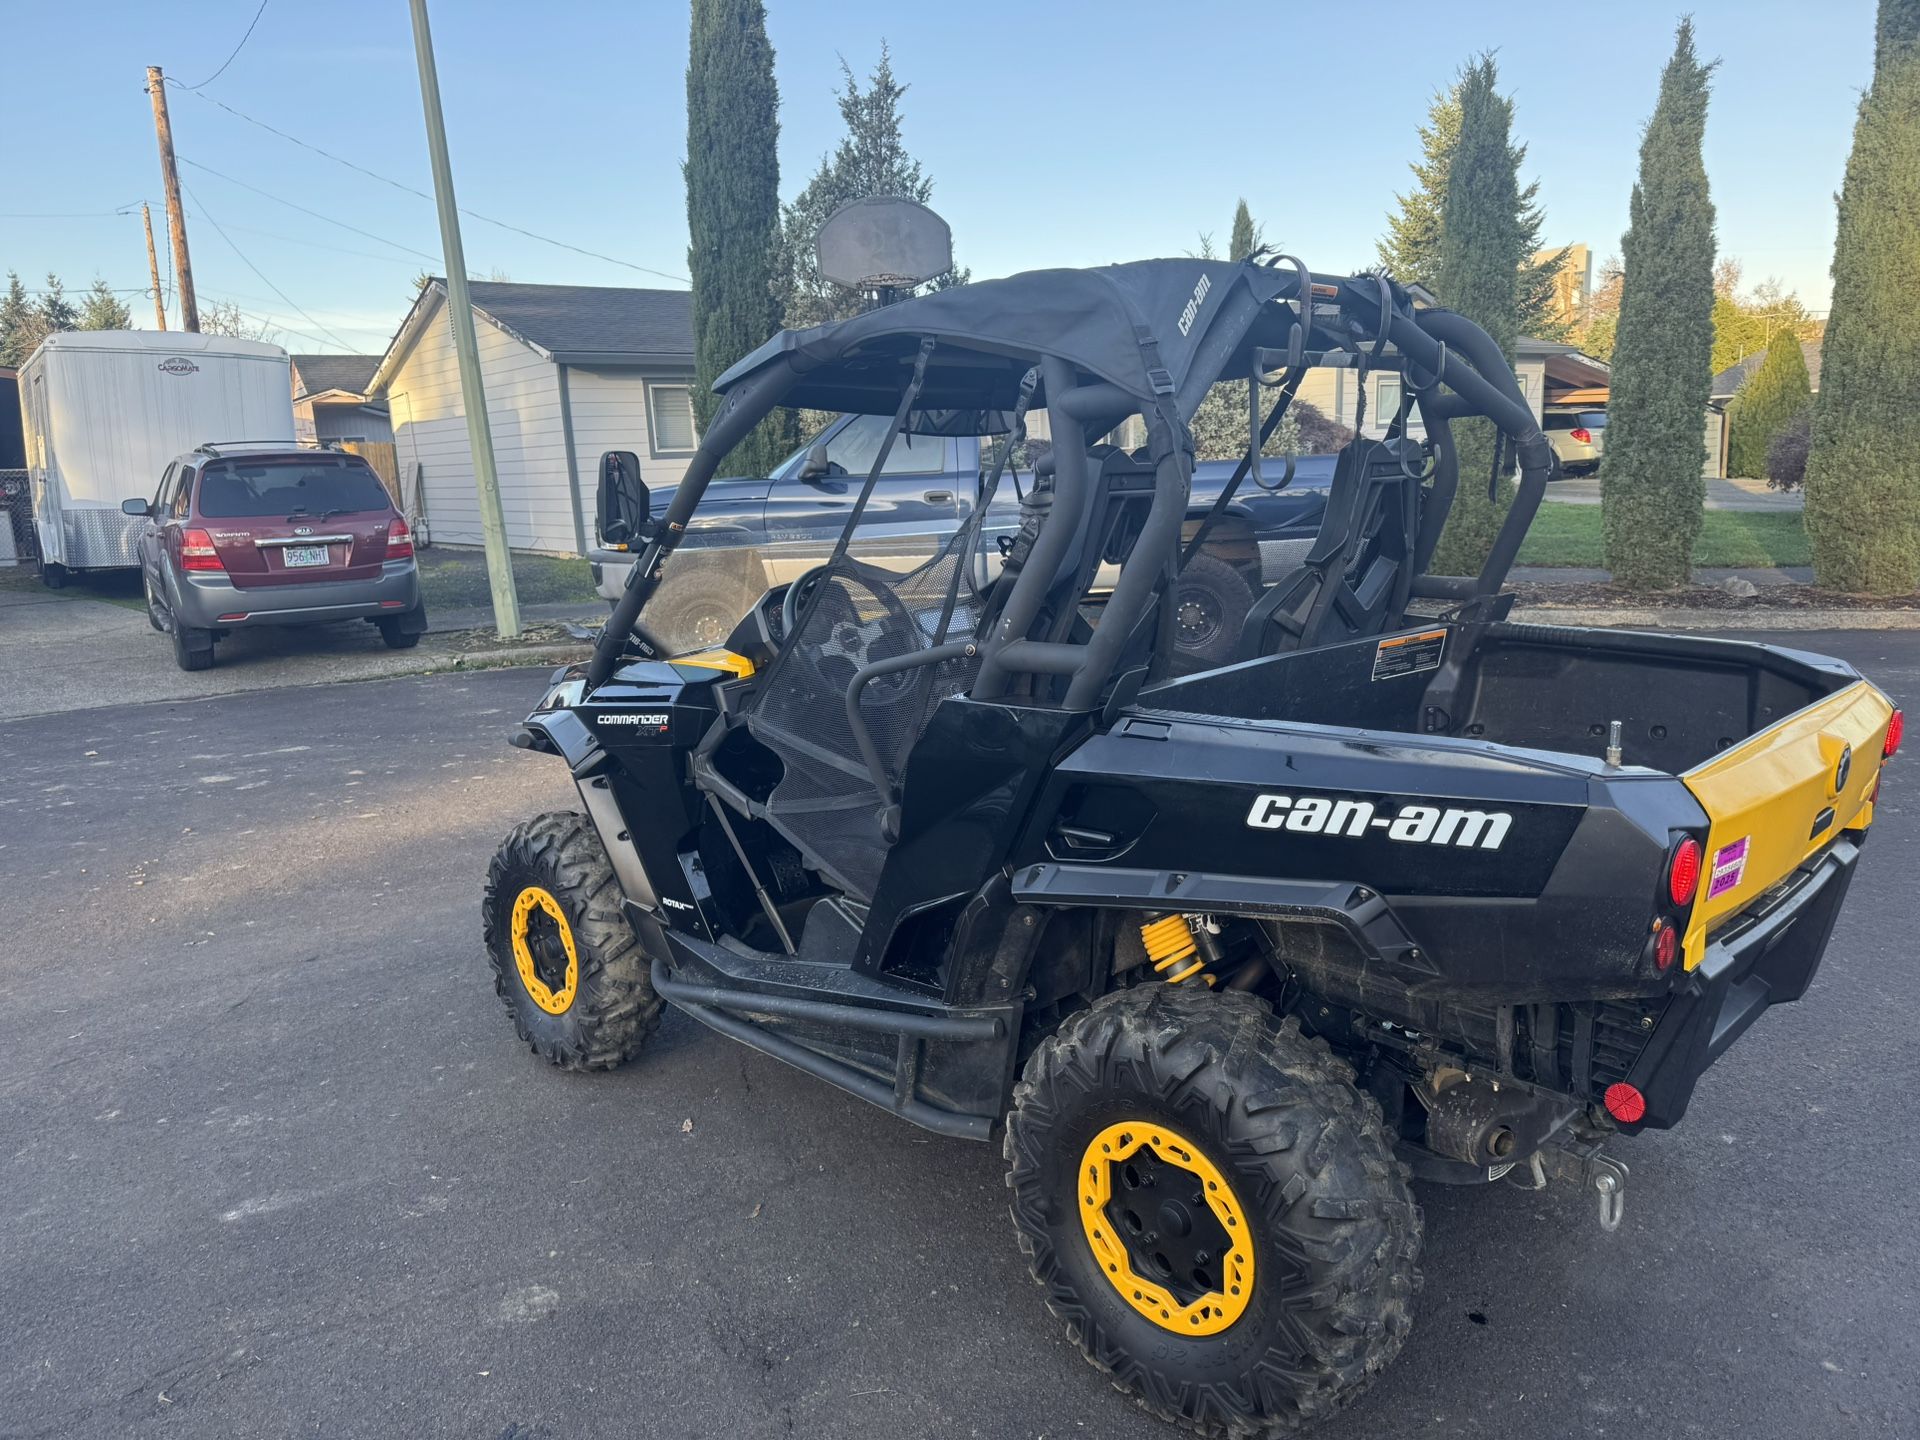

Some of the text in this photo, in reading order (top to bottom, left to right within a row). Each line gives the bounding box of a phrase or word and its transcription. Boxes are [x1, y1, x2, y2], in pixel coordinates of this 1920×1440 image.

[1177, 273, 1212, 337] can-am
[287, 550, 326, 562] 956 NHT
[597, 714, 669, 725] COMMANDER
[1246, 794, 1513, 850] can-am
[1714, 872, 1736, 890] 2025
[662, 896, 685, 911] ROTAX
